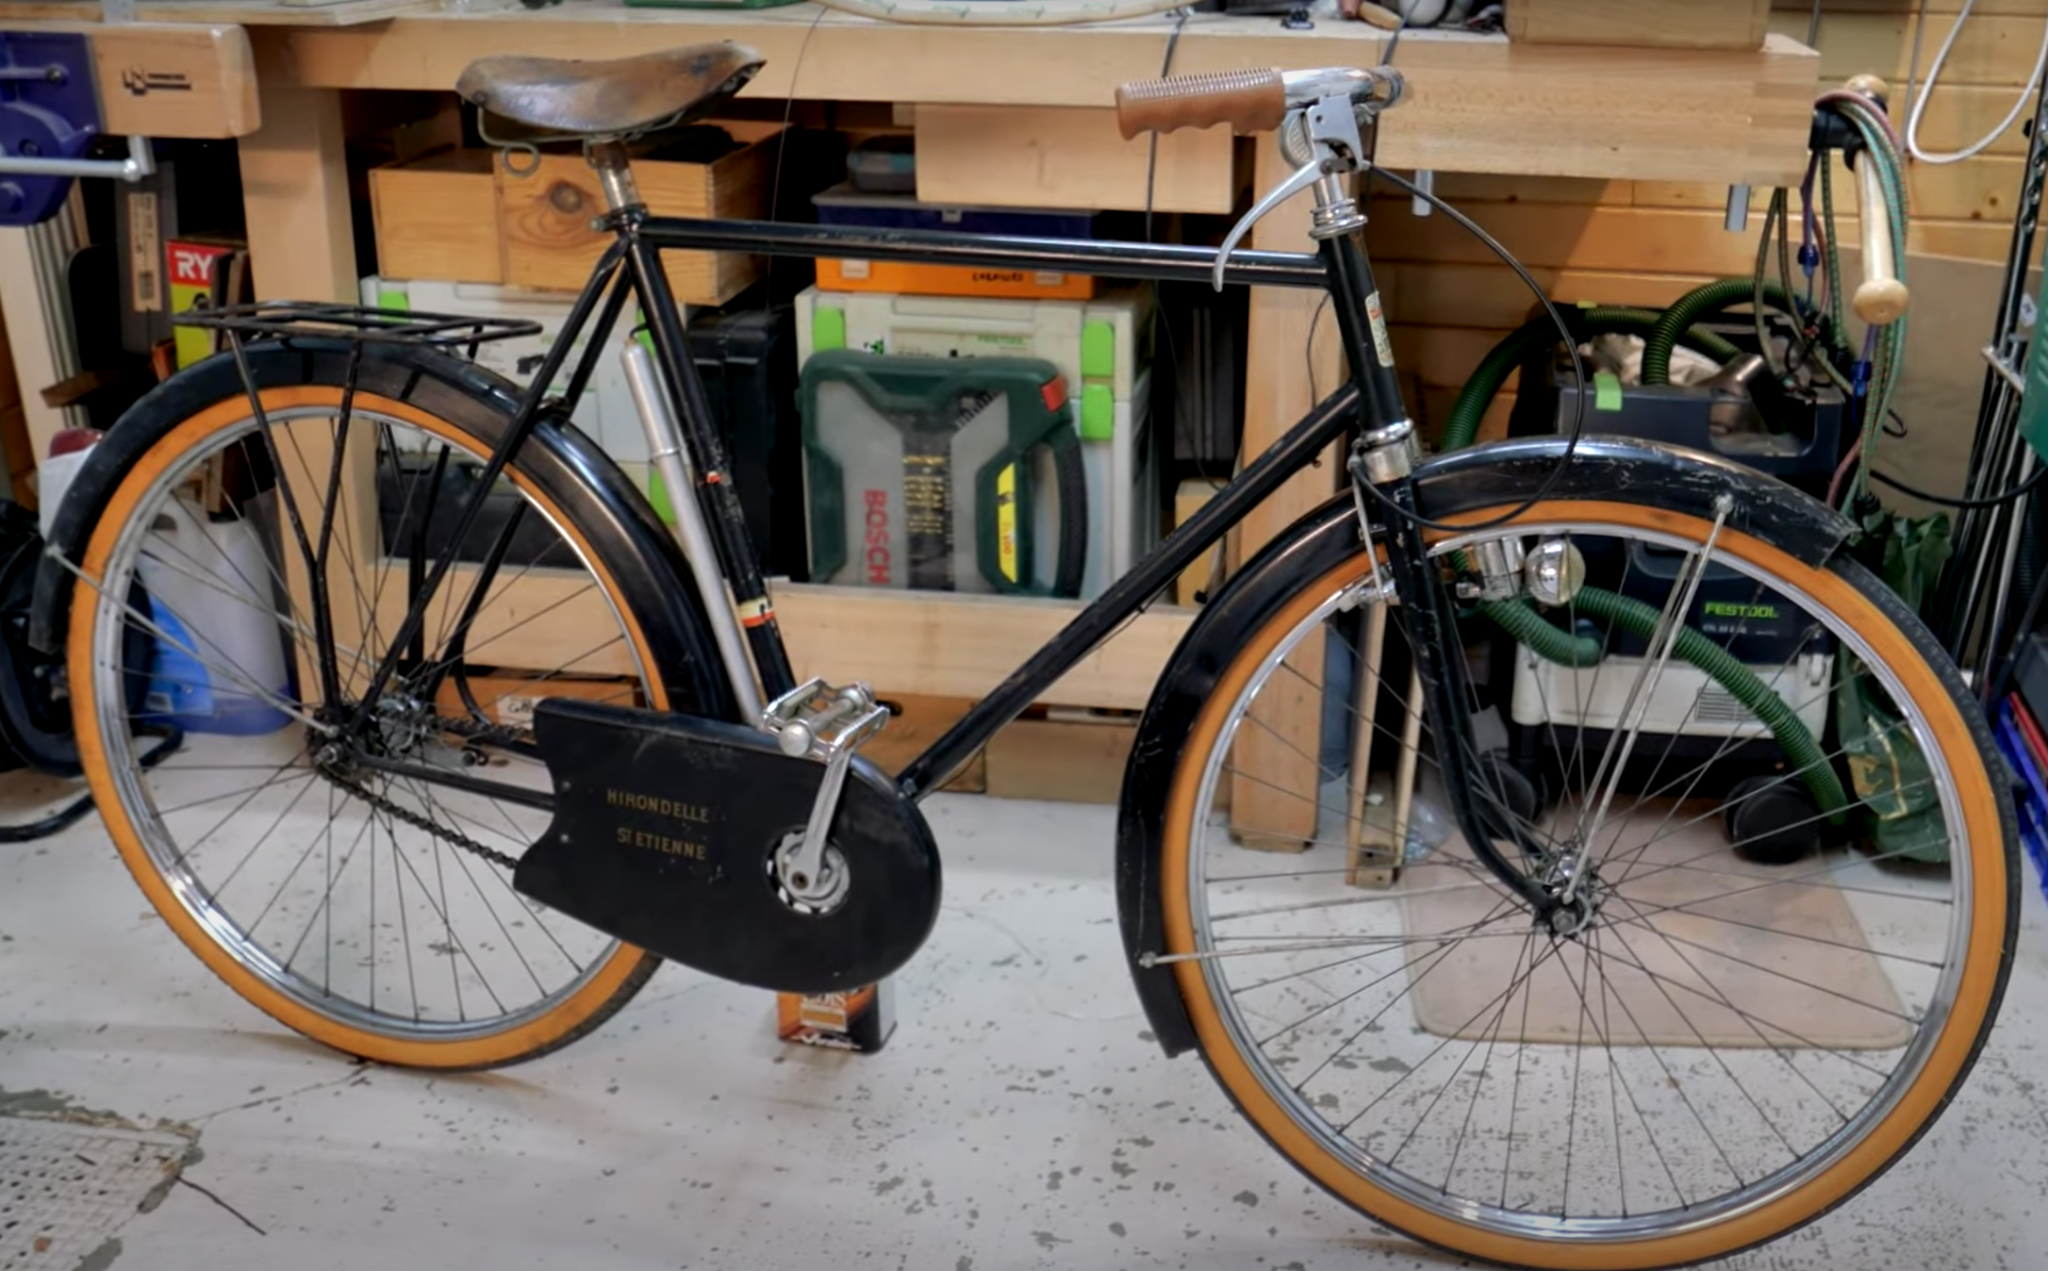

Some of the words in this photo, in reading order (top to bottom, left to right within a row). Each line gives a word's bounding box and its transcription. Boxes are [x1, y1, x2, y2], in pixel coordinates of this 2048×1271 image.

[864, 489, 890, 585] BOSCH
[1705, 602, 1779, 618] FESTOOL
[607, 788, 709, 823] HIRONDELLE
[635, 831, 706, 860] ETIENNE
